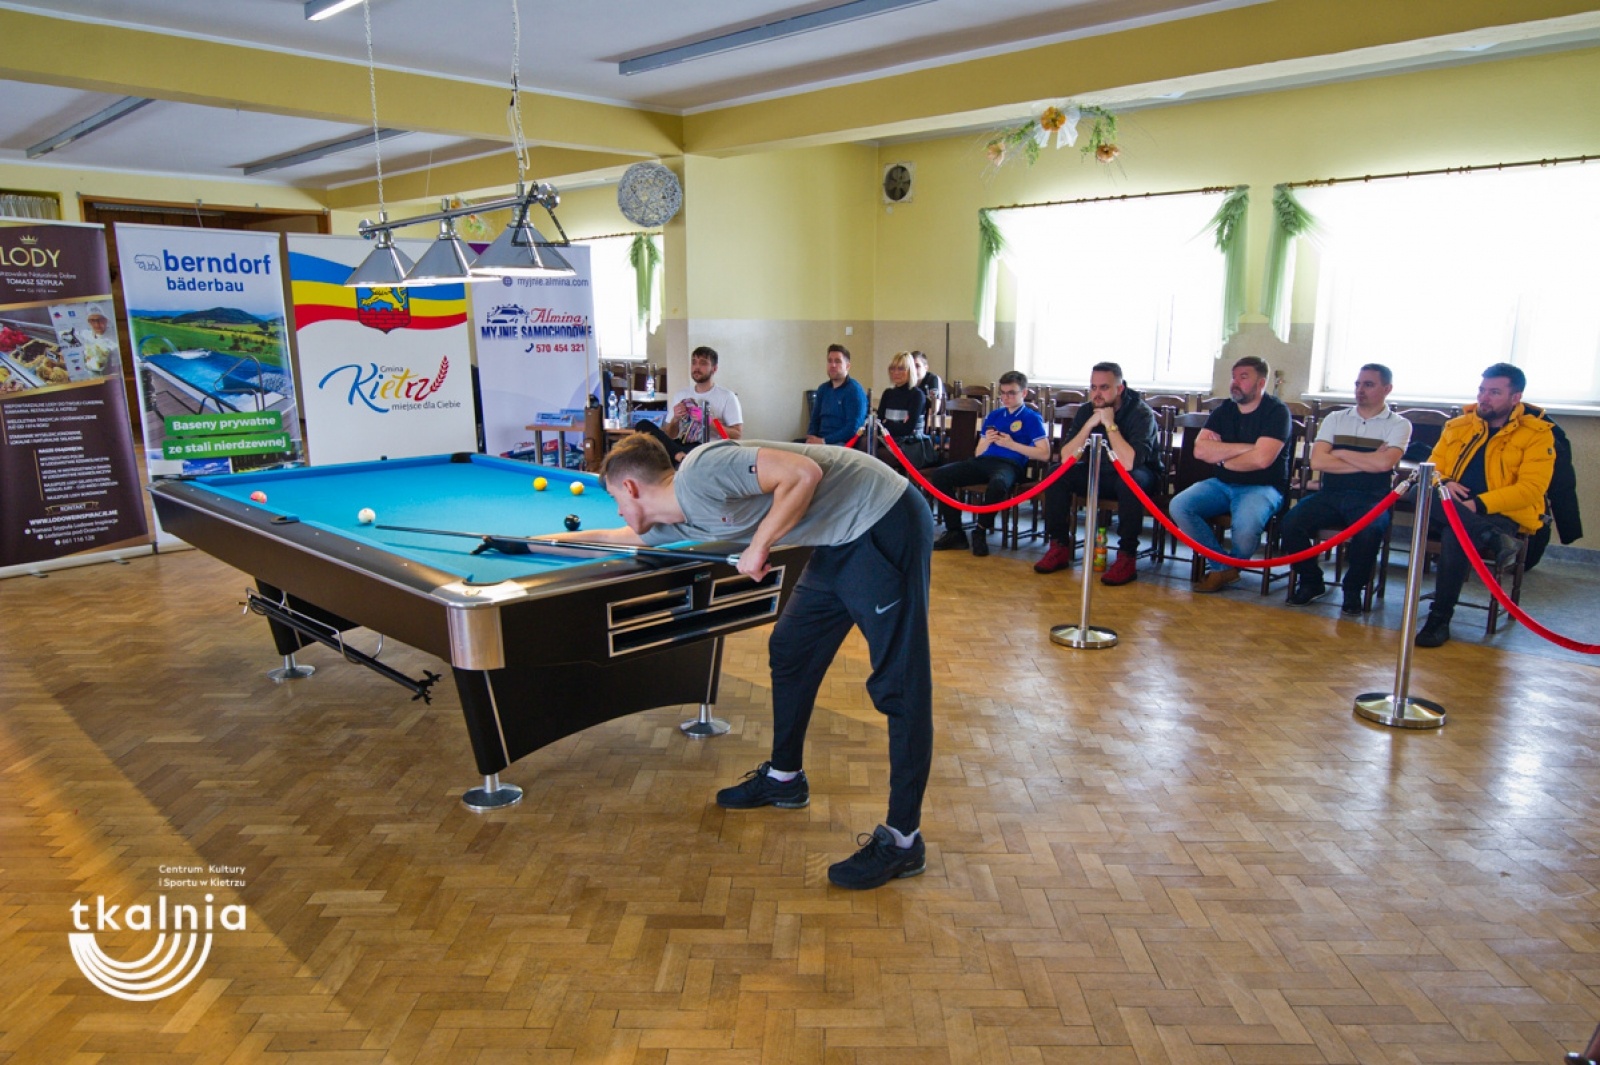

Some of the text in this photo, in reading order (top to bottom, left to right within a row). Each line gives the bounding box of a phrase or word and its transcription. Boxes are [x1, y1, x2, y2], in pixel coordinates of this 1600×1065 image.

[0, 246, 61, 268] LODY
[163, 249, 271, 275] berndorf
[166, 276, 244, 292] bäderbau
[517, 277, 589, 288] myjnie.almina.com
[530, 307, 584, 327] Almina
[481, 325, 592, 340] MYJNIE SAMOCHODOWE
[536, 343, 585, 353] 570 454 321
[380, 365, 404, 373] Gmina
[318, 362, 431, 413] Kietrz
[391, 400, 461, 412] miejsce dla Ciebie
[172, 416, 276, 431] Baseny prywatne
[168, 436, 287, 454] ze stali nierdzewnej
